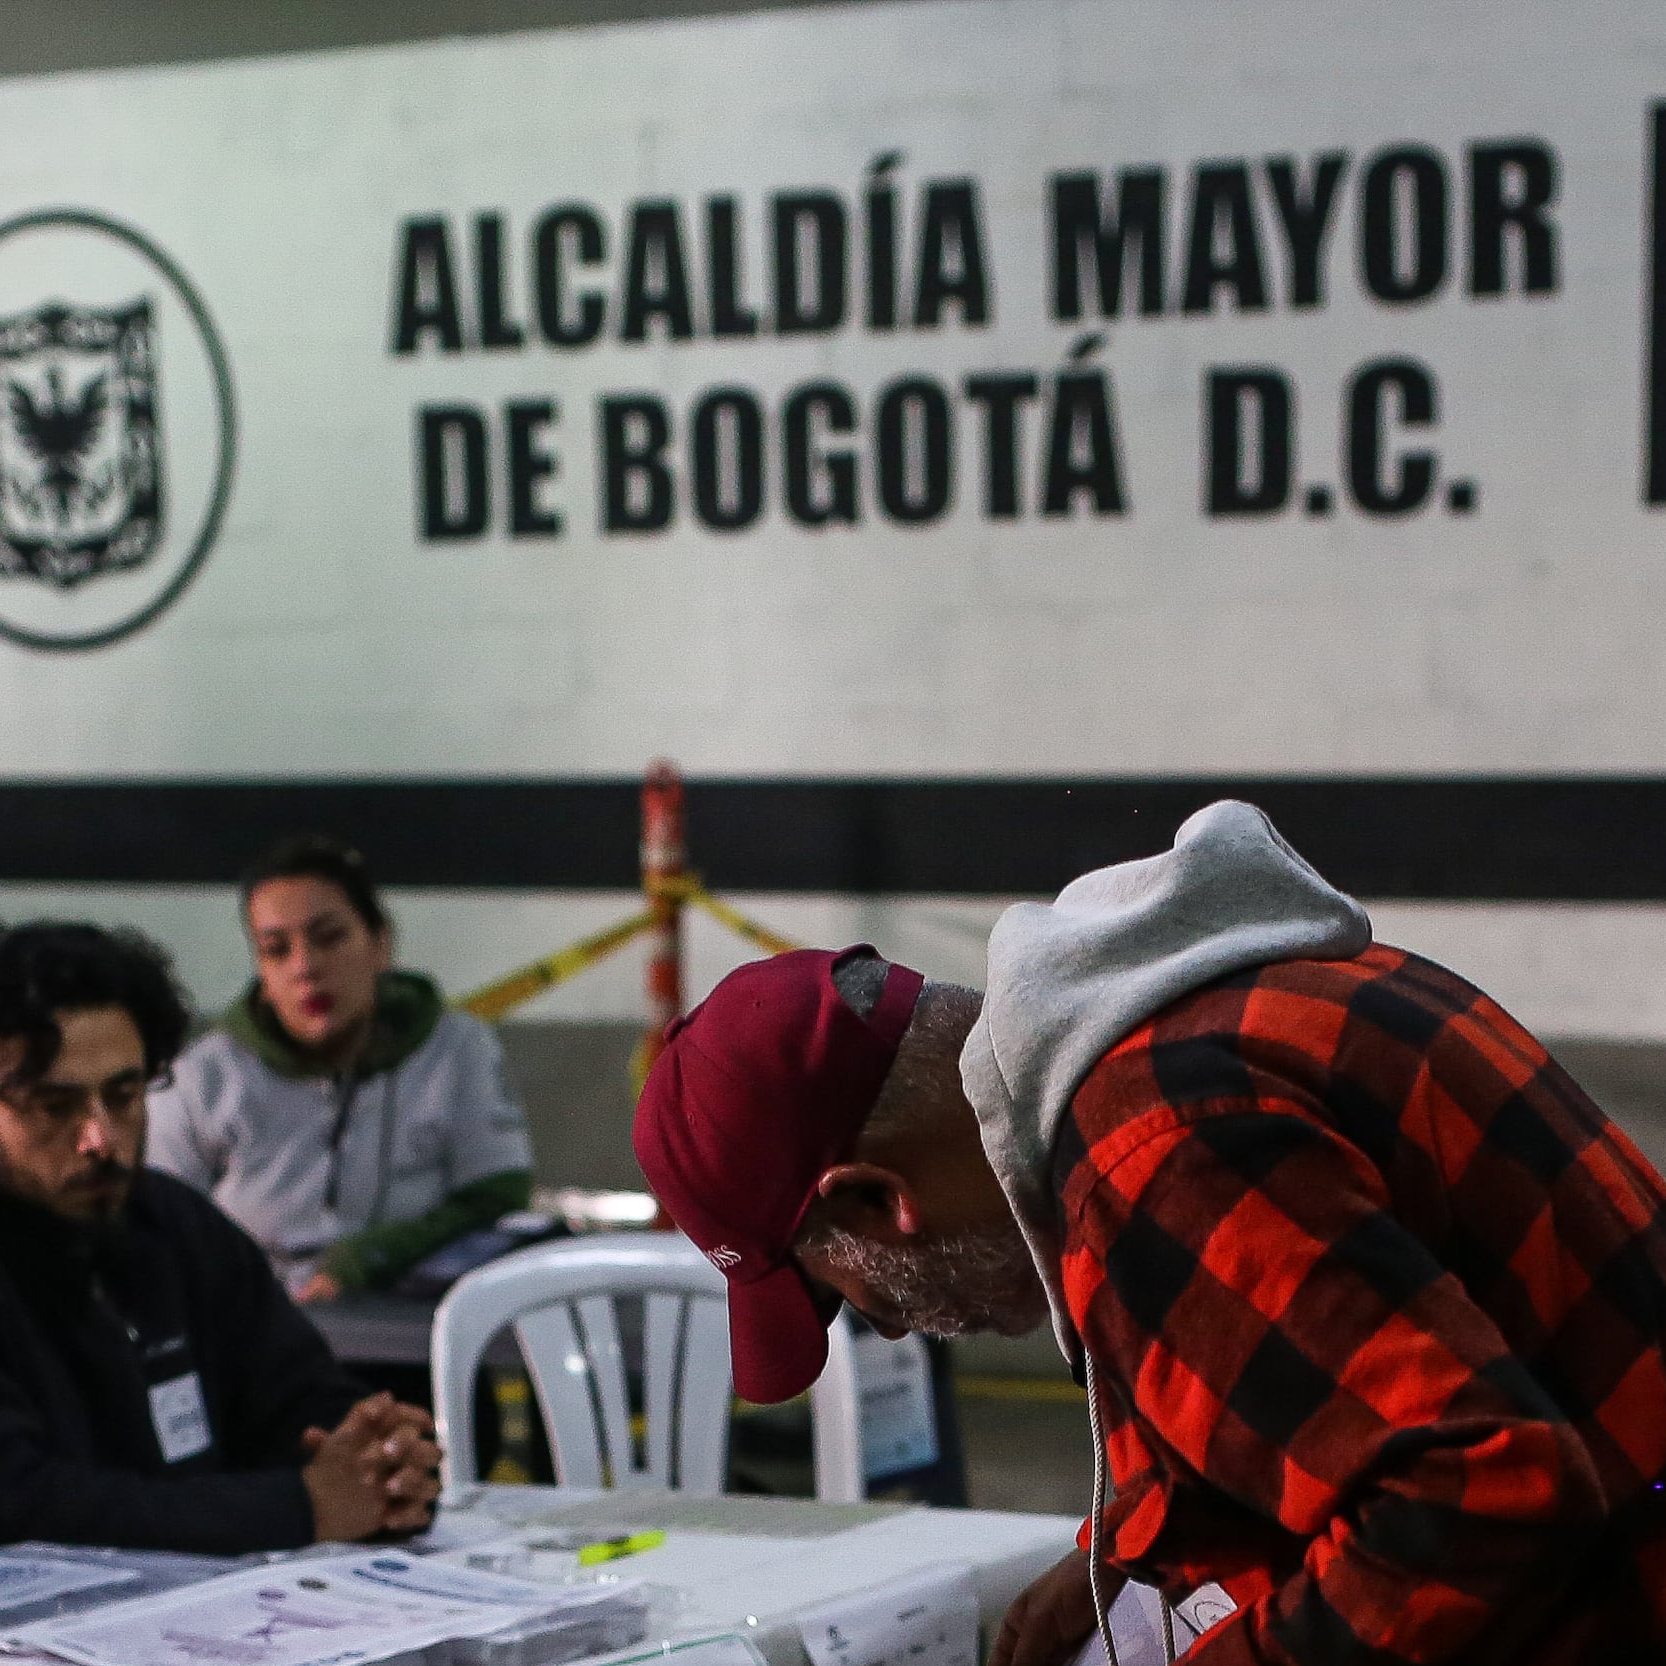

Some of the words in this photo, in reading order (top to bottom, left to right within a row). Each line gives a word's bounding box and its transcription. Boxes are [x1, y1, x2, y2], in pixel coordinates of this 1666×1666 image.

[390, 152, 993, 357] ALCALDÍA
[1048, 138, 1561, 323] MAYOR
[416, 400, 564, 545] DE
[598, 333, 1129, 535] BOGOTÁ
[1203, 356, 1477, 520] D.C.
